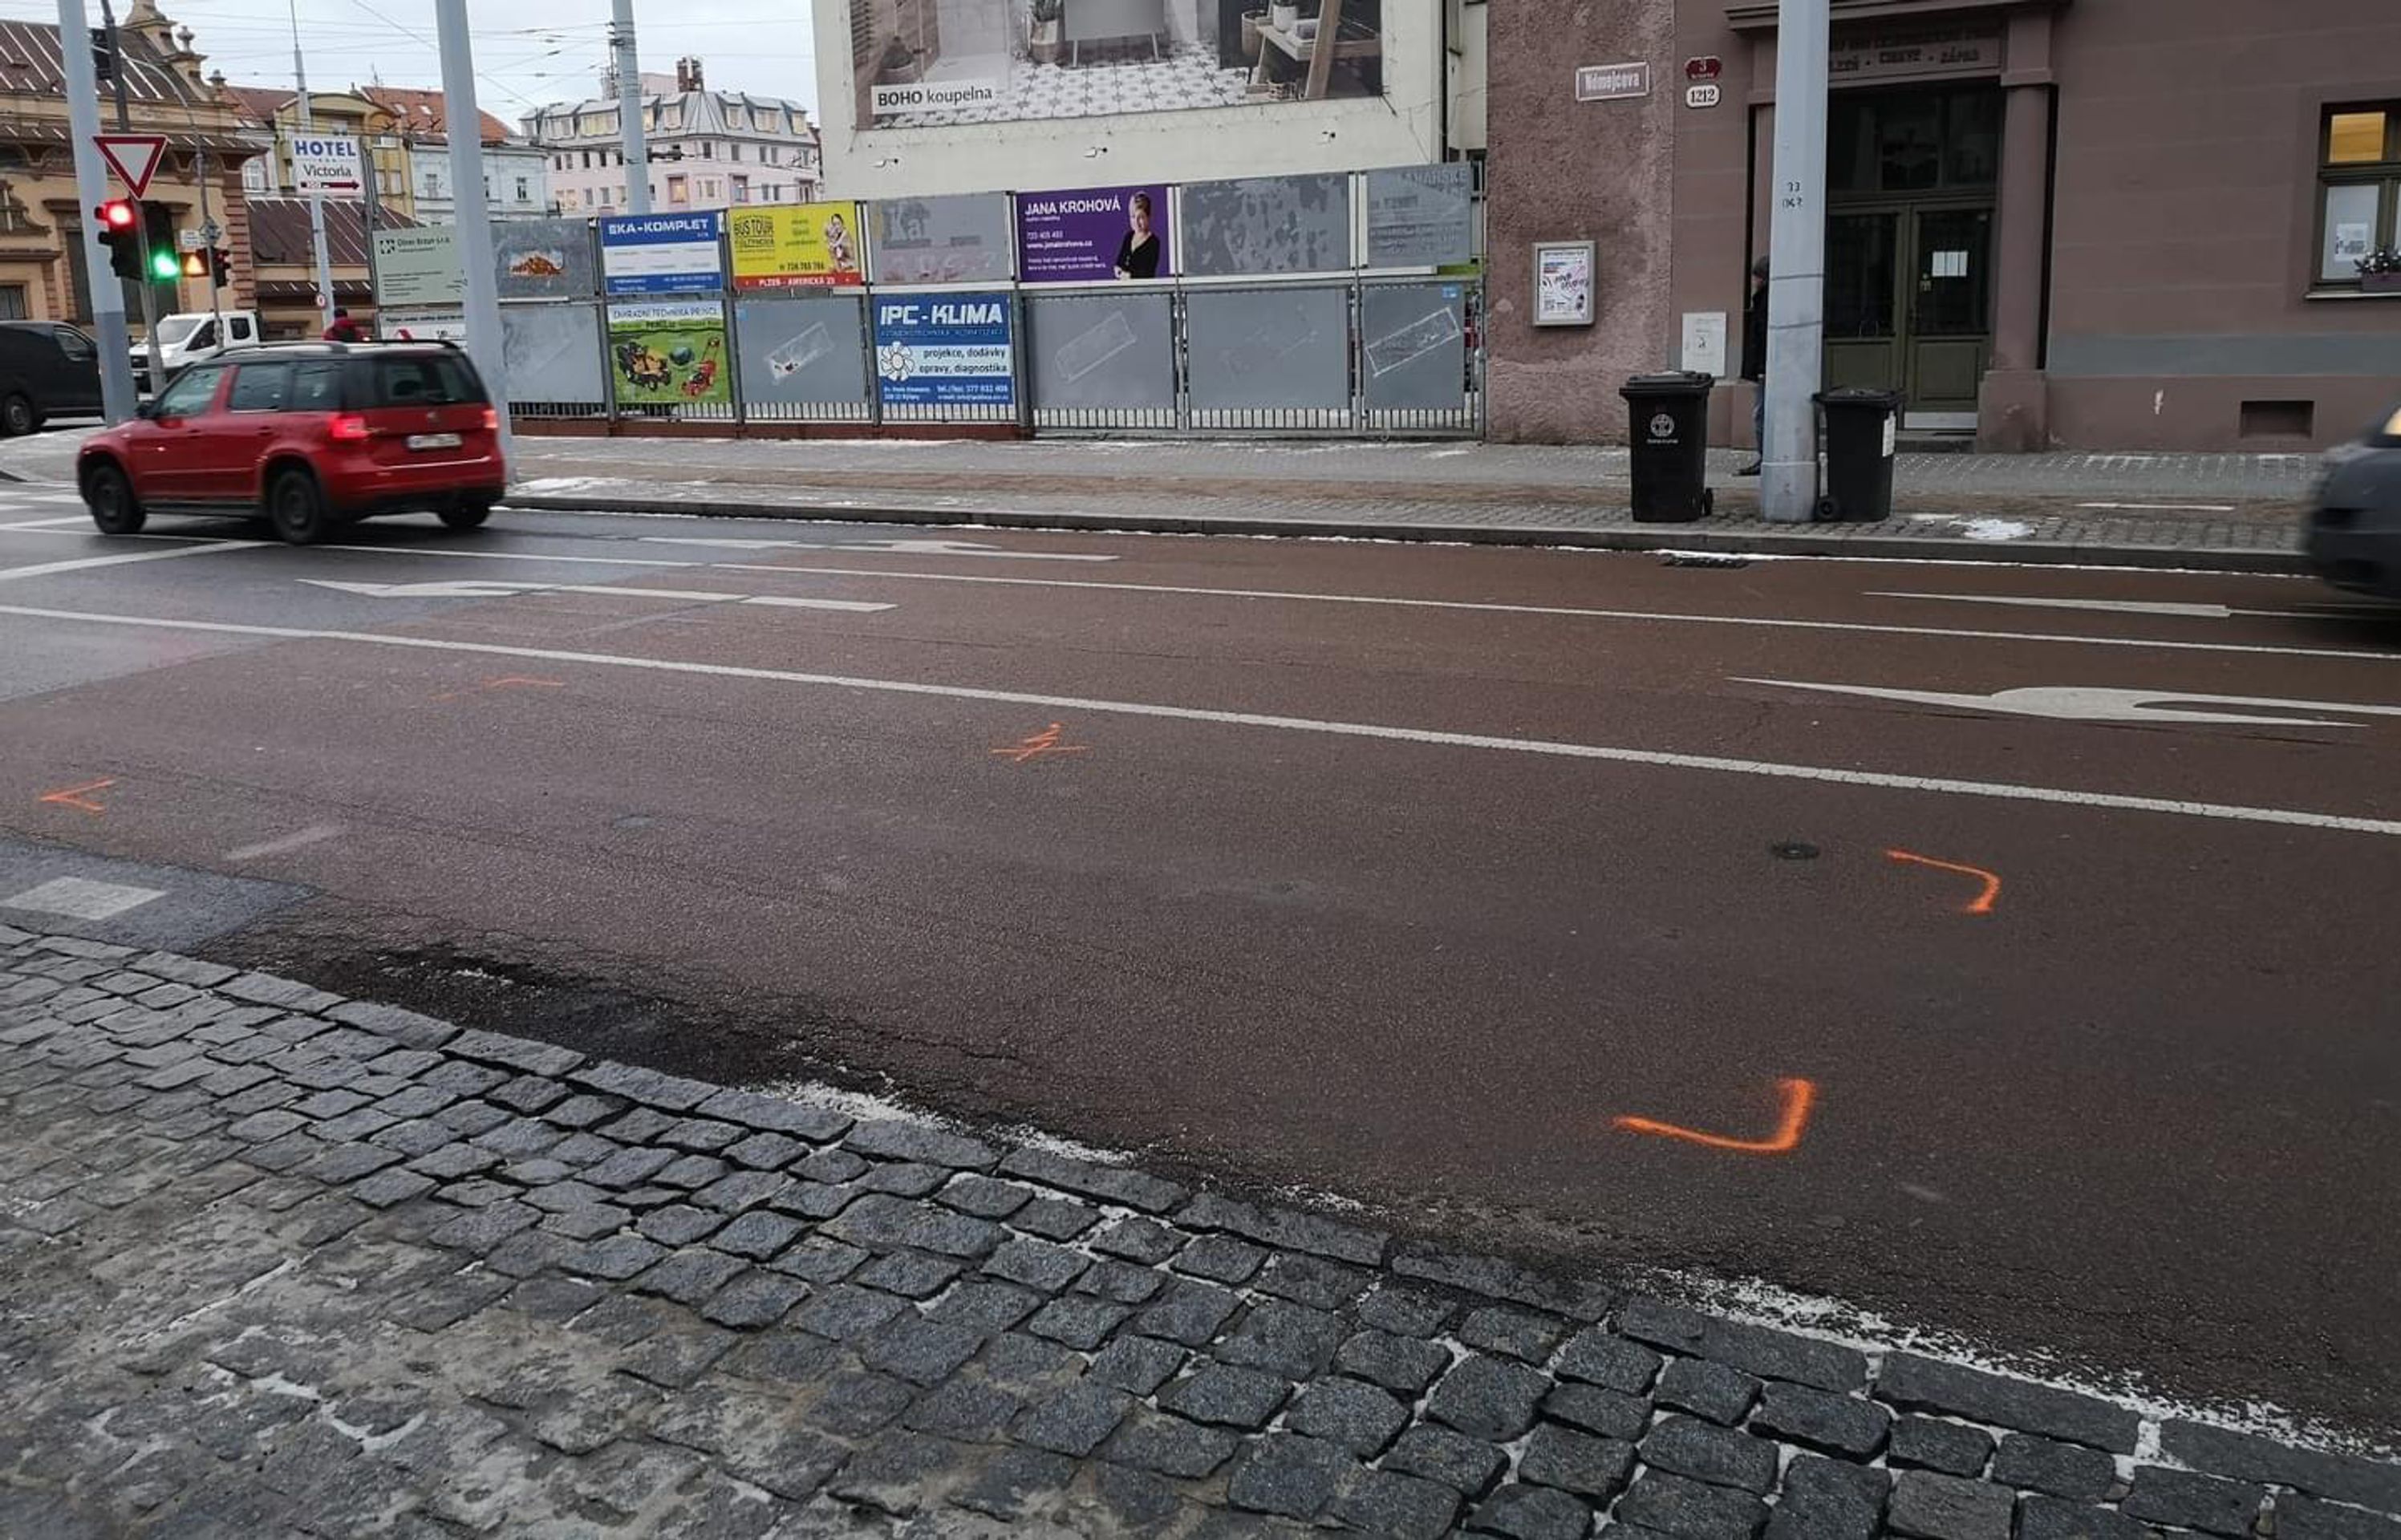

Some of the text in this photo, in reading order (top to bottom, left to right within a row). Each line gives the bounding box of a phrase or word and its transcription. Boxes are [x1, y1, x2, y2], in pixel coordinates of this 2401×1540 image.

[878, 86, 992, 107] BOHO koupelna
[1690, 89, 1715, 103] 1212
[294, 140, 356, 156] HOTEL
[303, 164, 352, 177] Victoria
[1024, 194, 1121, 215] JANA KROHOVÁ
[734, 219, 750, 236] BUS
[880, 306, 919, 325] IPC
[931, 303, 1003, 325] KLIMA
[923, 347, 1006, 359] projekce, dodávky
[919, 363, 1007, 375] opravy, diagnostika
